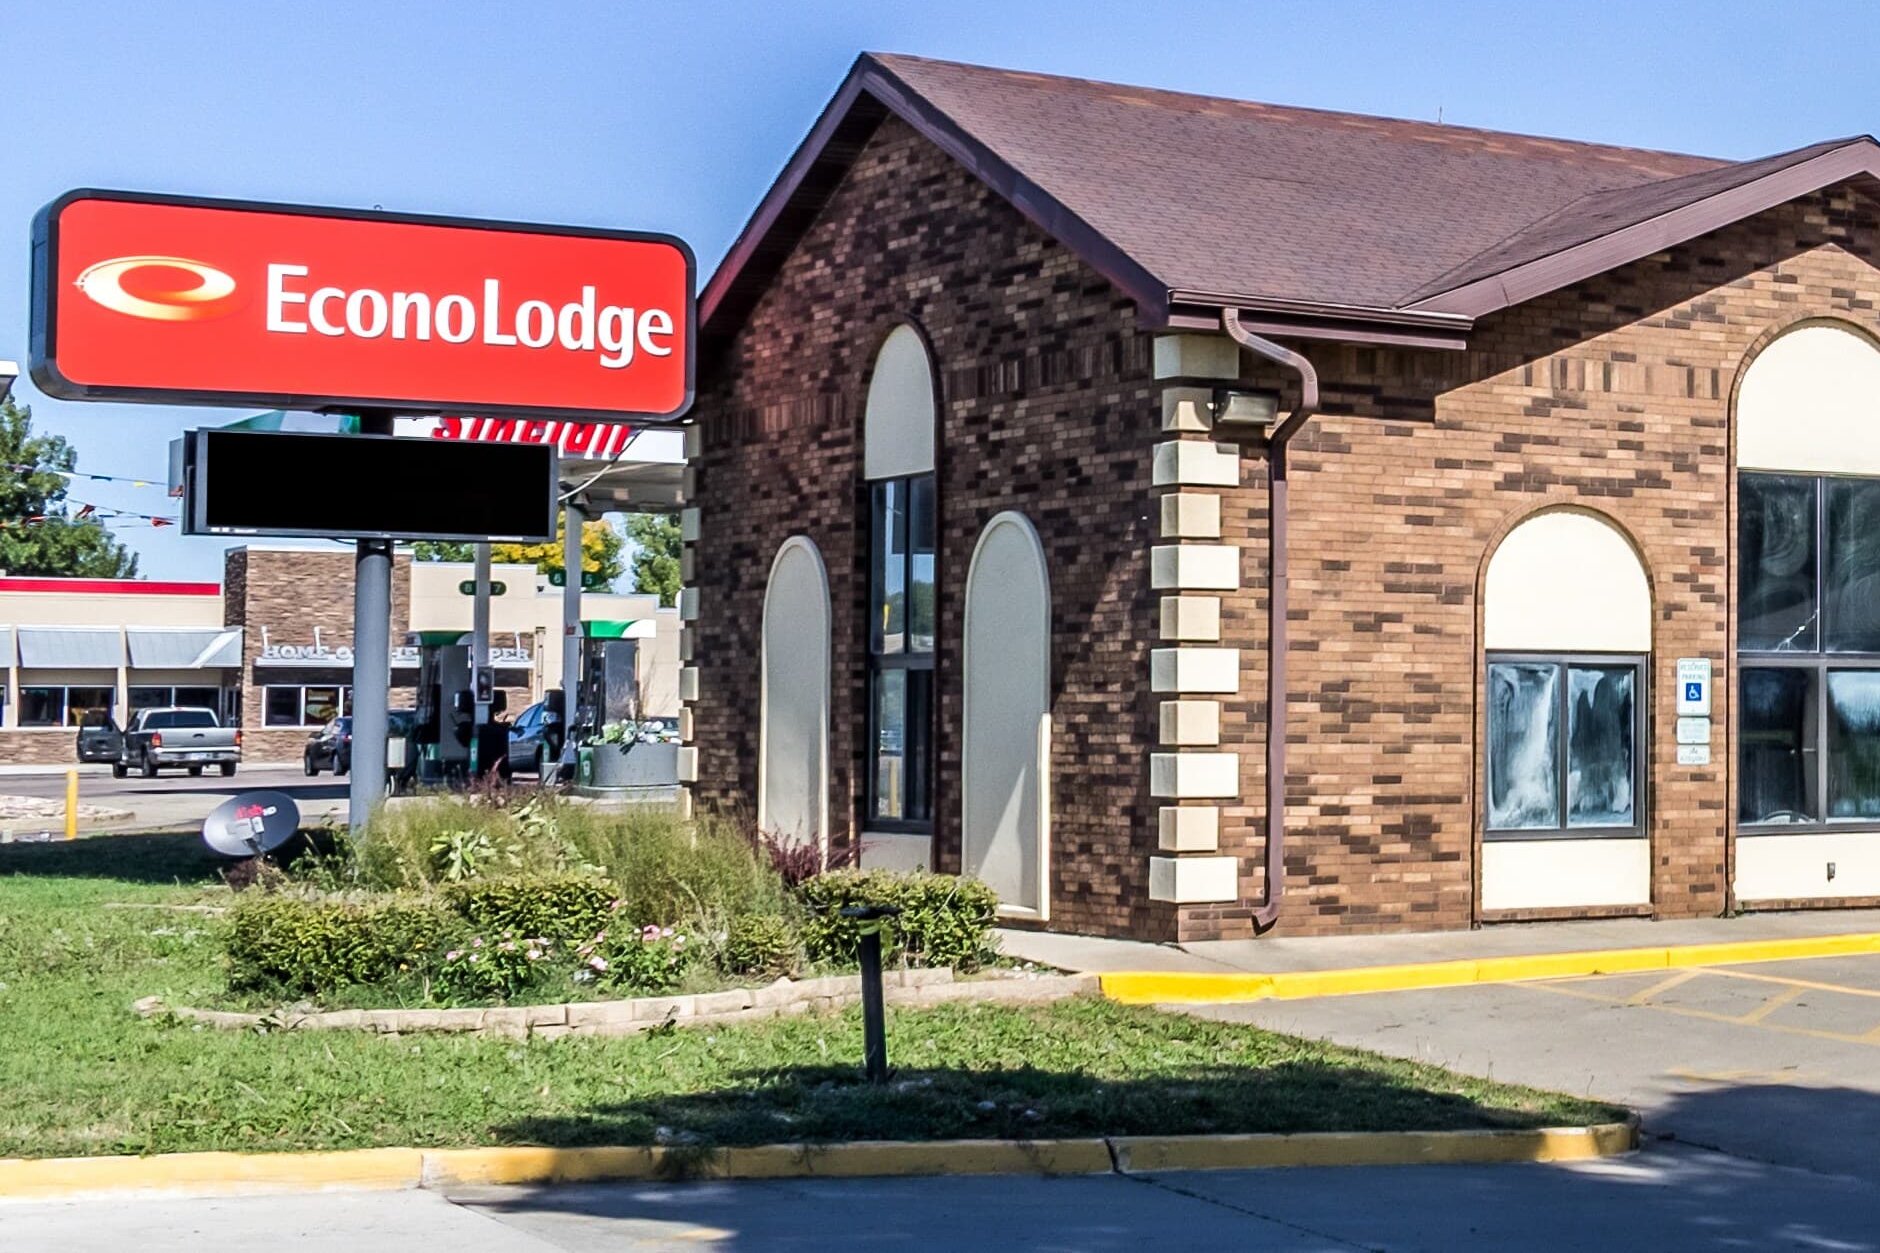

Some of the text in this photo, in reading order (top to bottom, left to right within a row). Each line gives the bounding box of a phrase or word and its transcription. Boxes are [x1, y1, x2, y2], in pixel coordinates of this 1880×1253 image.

[266, 263, 674, 368] EconoLodge
[586, 574, 593, 585] 5
[262, 645, 330, 660] HOME
[336, 645, 354, 660] O
